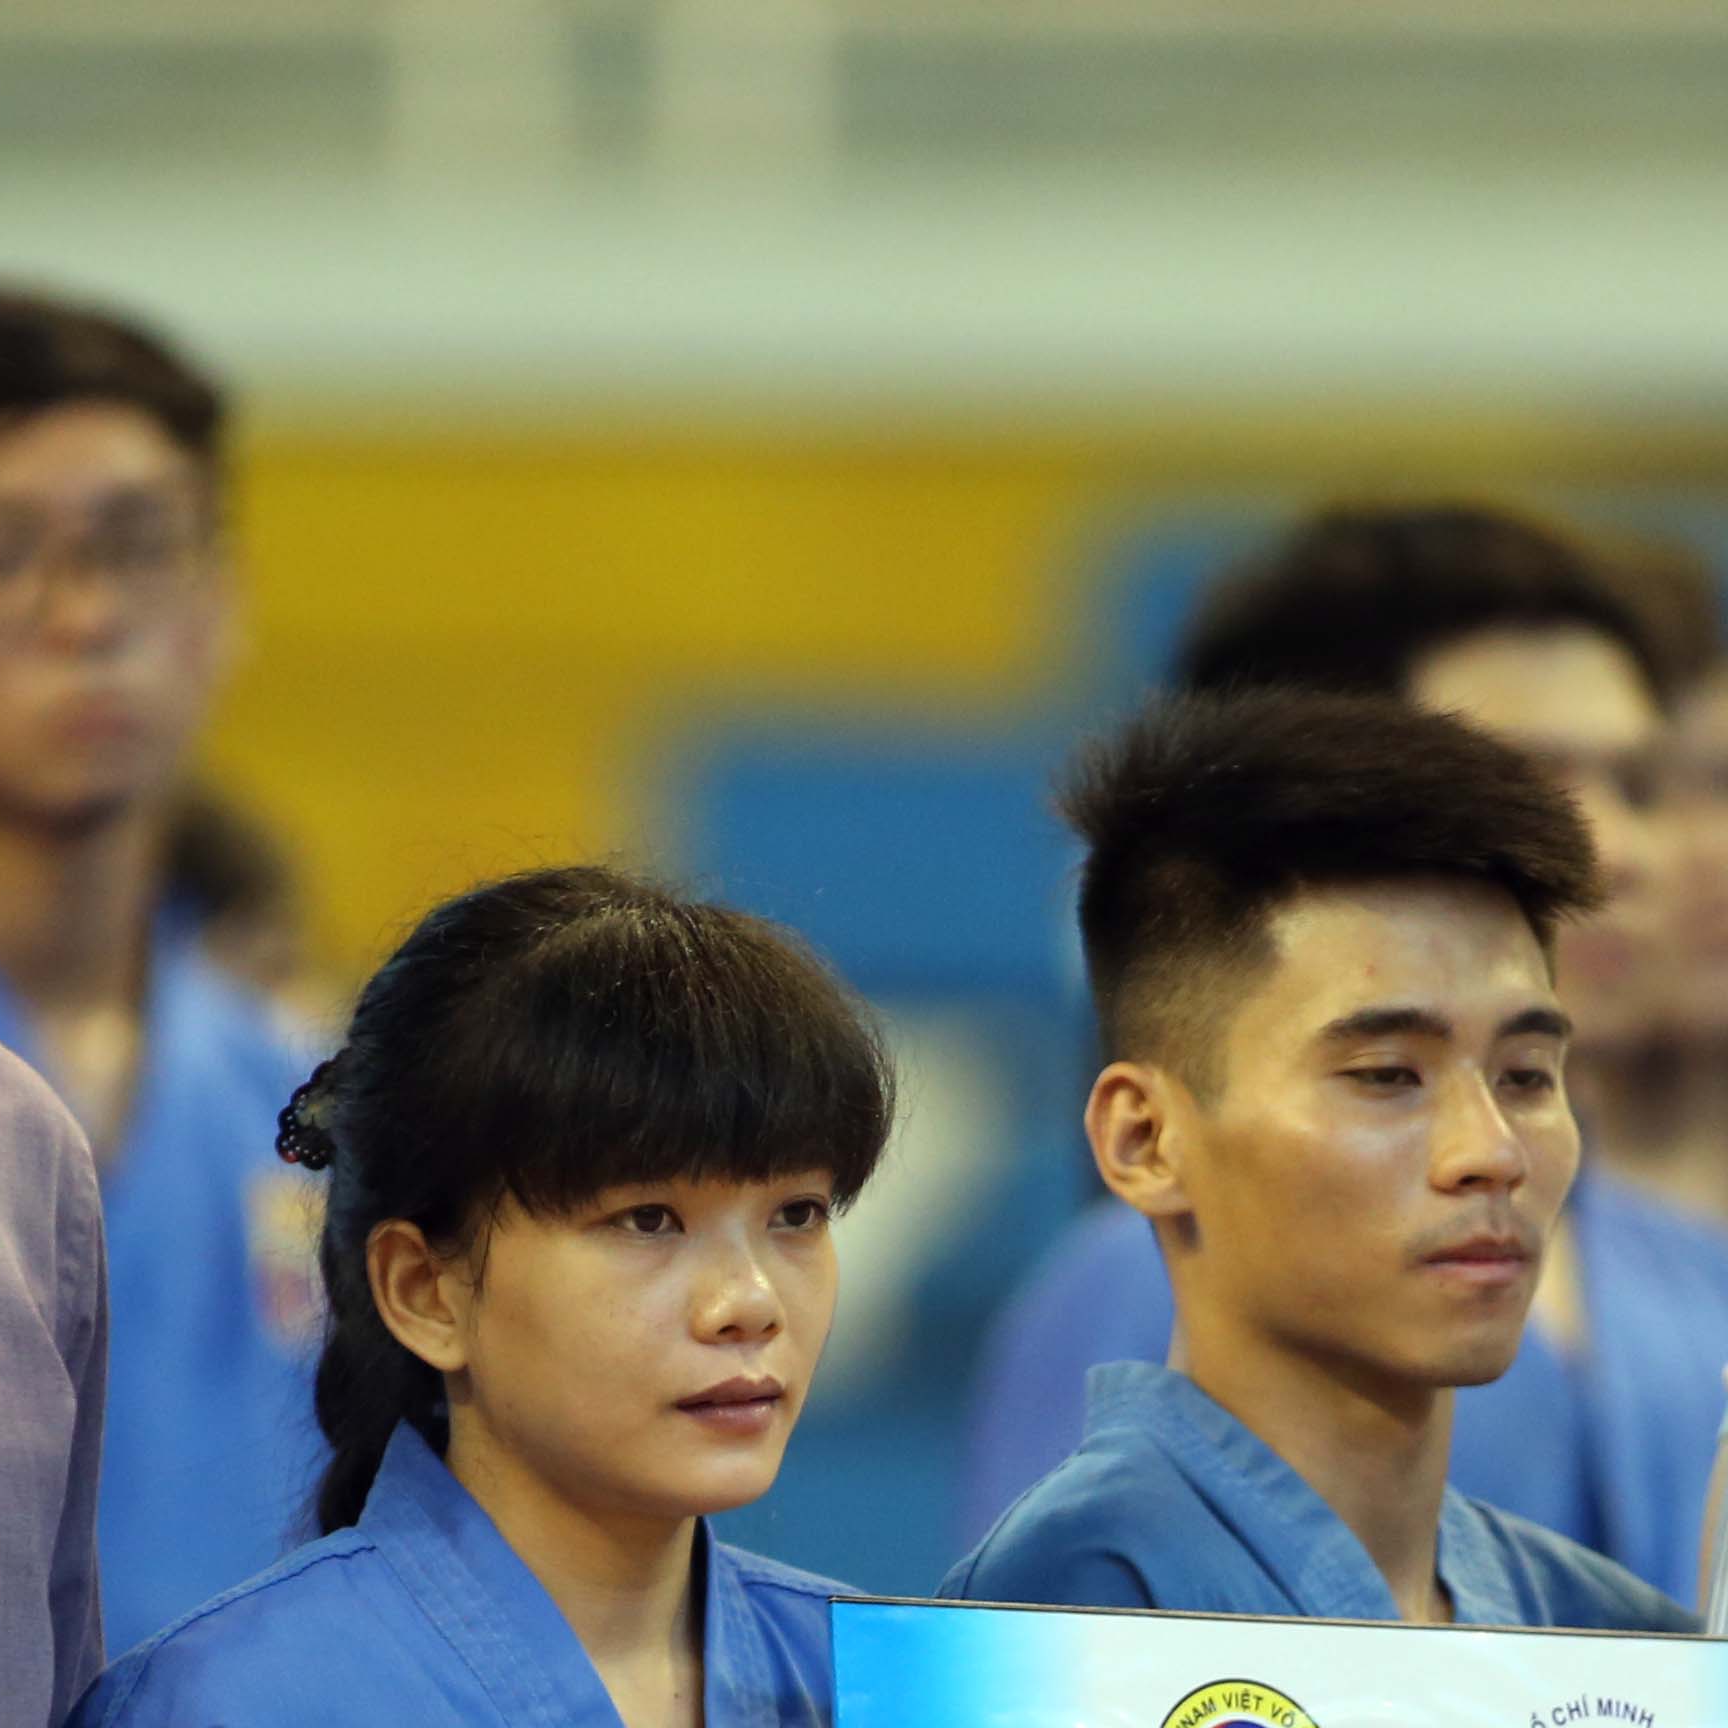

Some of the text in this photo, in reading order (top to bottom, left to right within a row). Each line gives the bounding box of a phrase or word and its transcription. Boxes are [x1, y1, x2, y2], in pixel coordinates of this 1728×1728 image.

[1222, 1688, 1264, 1711] VIỆT
[1552, 1693, 1589, 1726] CHÍ
[1597, 1698, 1655, 1728] MINH
